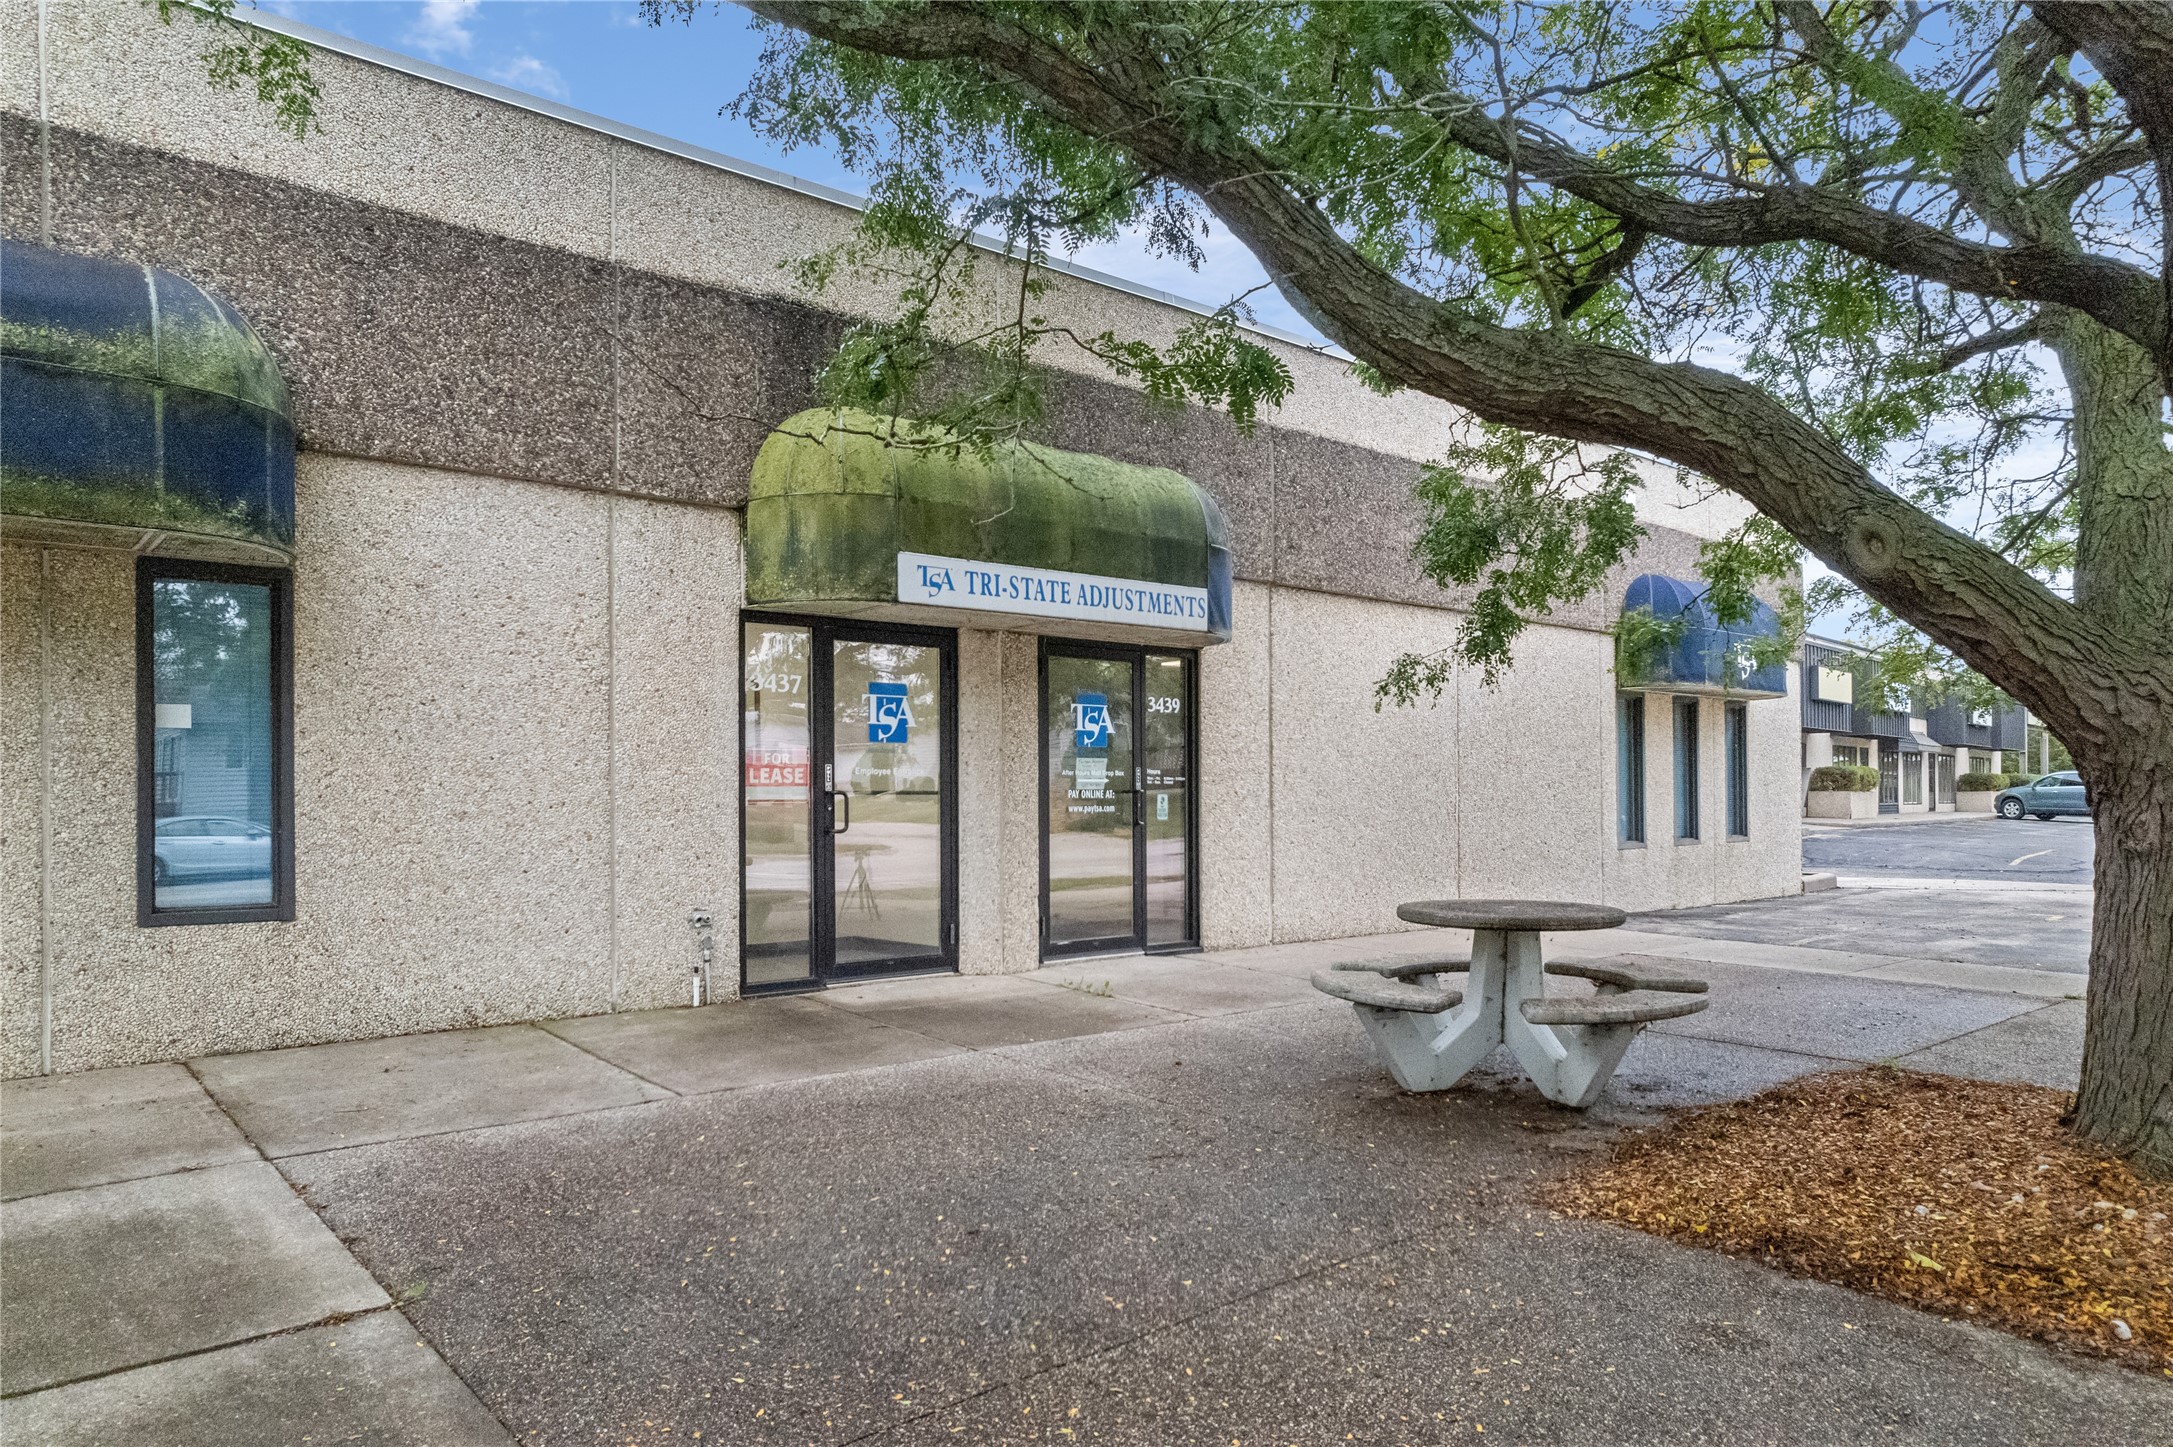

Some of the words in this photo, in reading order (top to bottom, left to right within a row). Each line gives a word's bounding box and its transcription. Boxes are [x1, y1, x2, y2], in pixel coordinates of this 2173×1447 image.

[917, 564, 956, 598] TSA
[965, 570, 1071, 605] TRI-STATE
[1077, 583, 1206, 619] ADJUSTMENTS
[750, 673, 802, 694] 3437
[1147, 696, 1181, 713] 3439
[861, 693, 917, 742] TSA
[1070, 703, 1116, 746] TSA
[764, 753, 790, 764] FOR
[749, 767, 805, 784] LEASE
[855, 767, 891, 777] Employee
[893, 767, 926, 777] Entra
[1068, 789, 1080, 799] PAY
[1081, 789, 1104, 799] ONLINE
[1105, 789, 1116, 799] AT:
